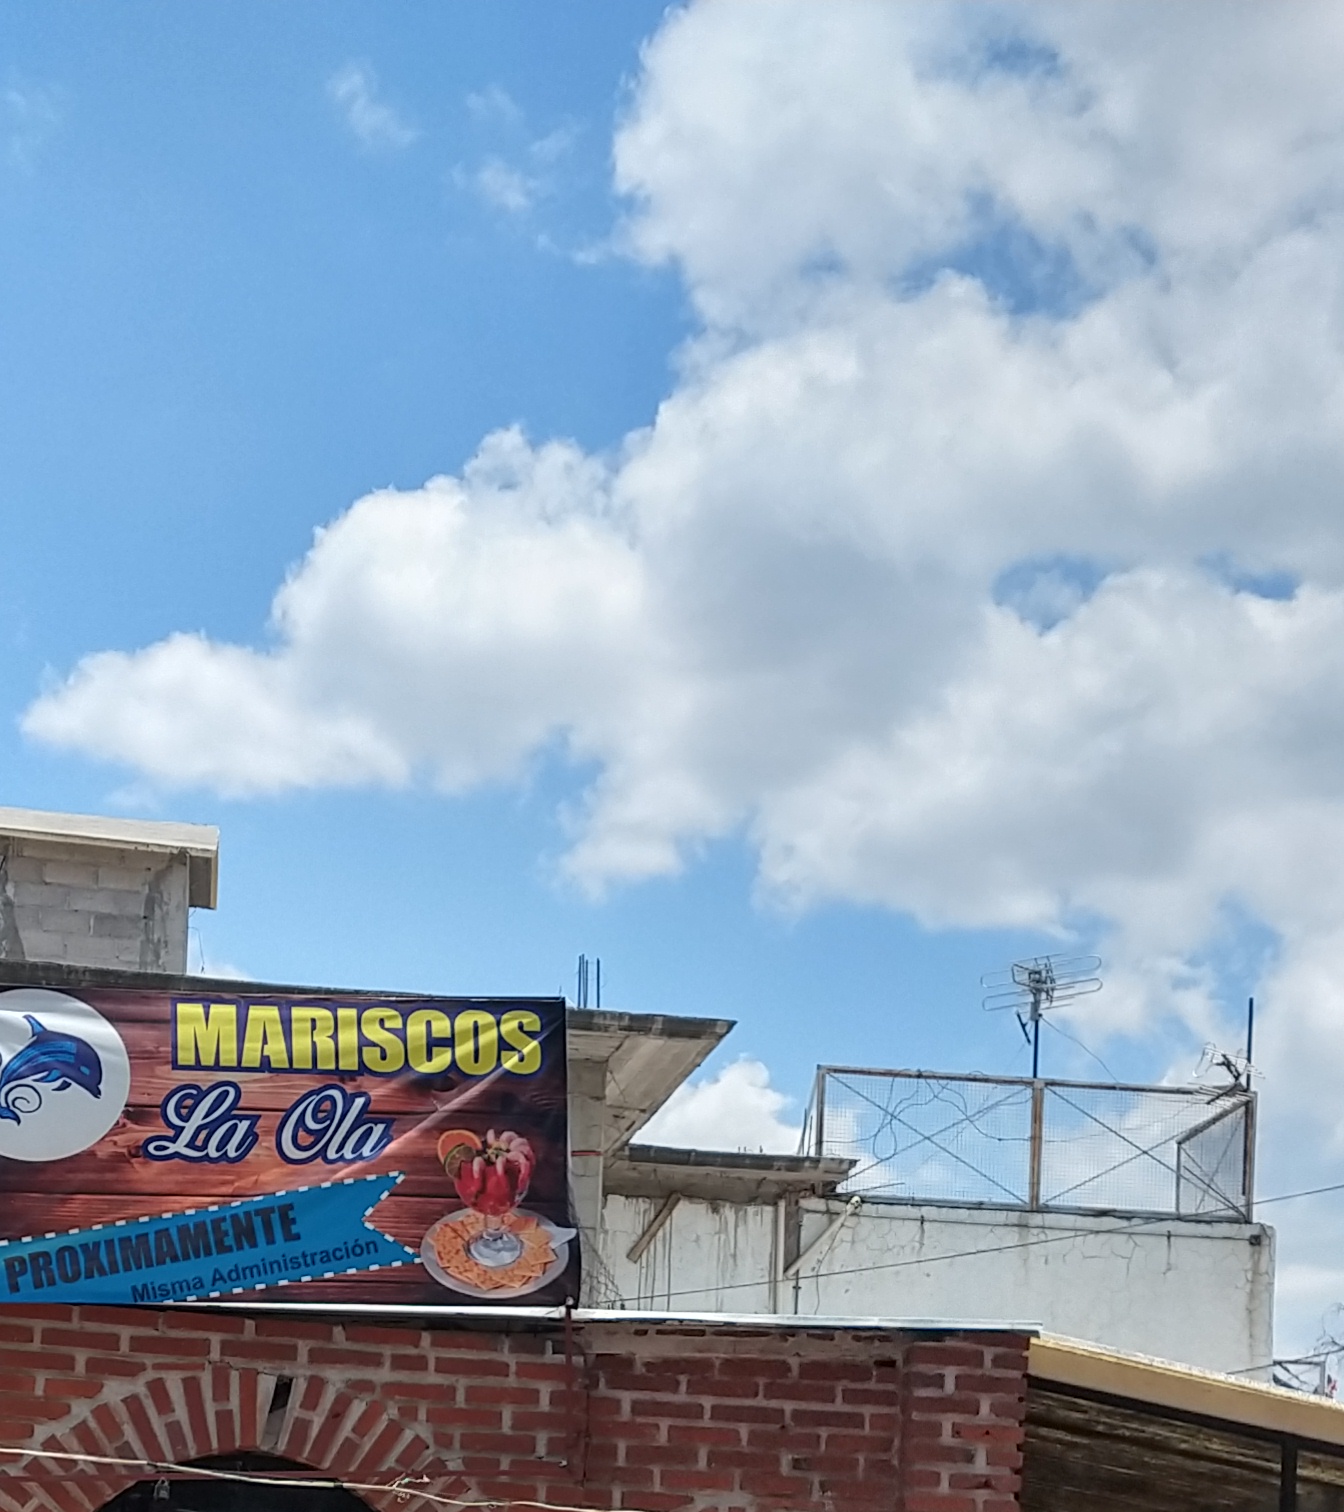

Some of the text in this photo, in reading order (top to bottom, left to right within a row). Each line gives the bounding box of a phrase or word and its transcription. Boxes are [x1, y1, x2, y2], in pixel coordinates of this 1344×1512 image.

[175, 1002, 543, 1076] MARISCOS
[146, 1085, 390, 1162] La Ola
[3, 1202, 301, 1294] PROXIMAMENTE
[130, 1238, 379, 1303] Misma Administración
